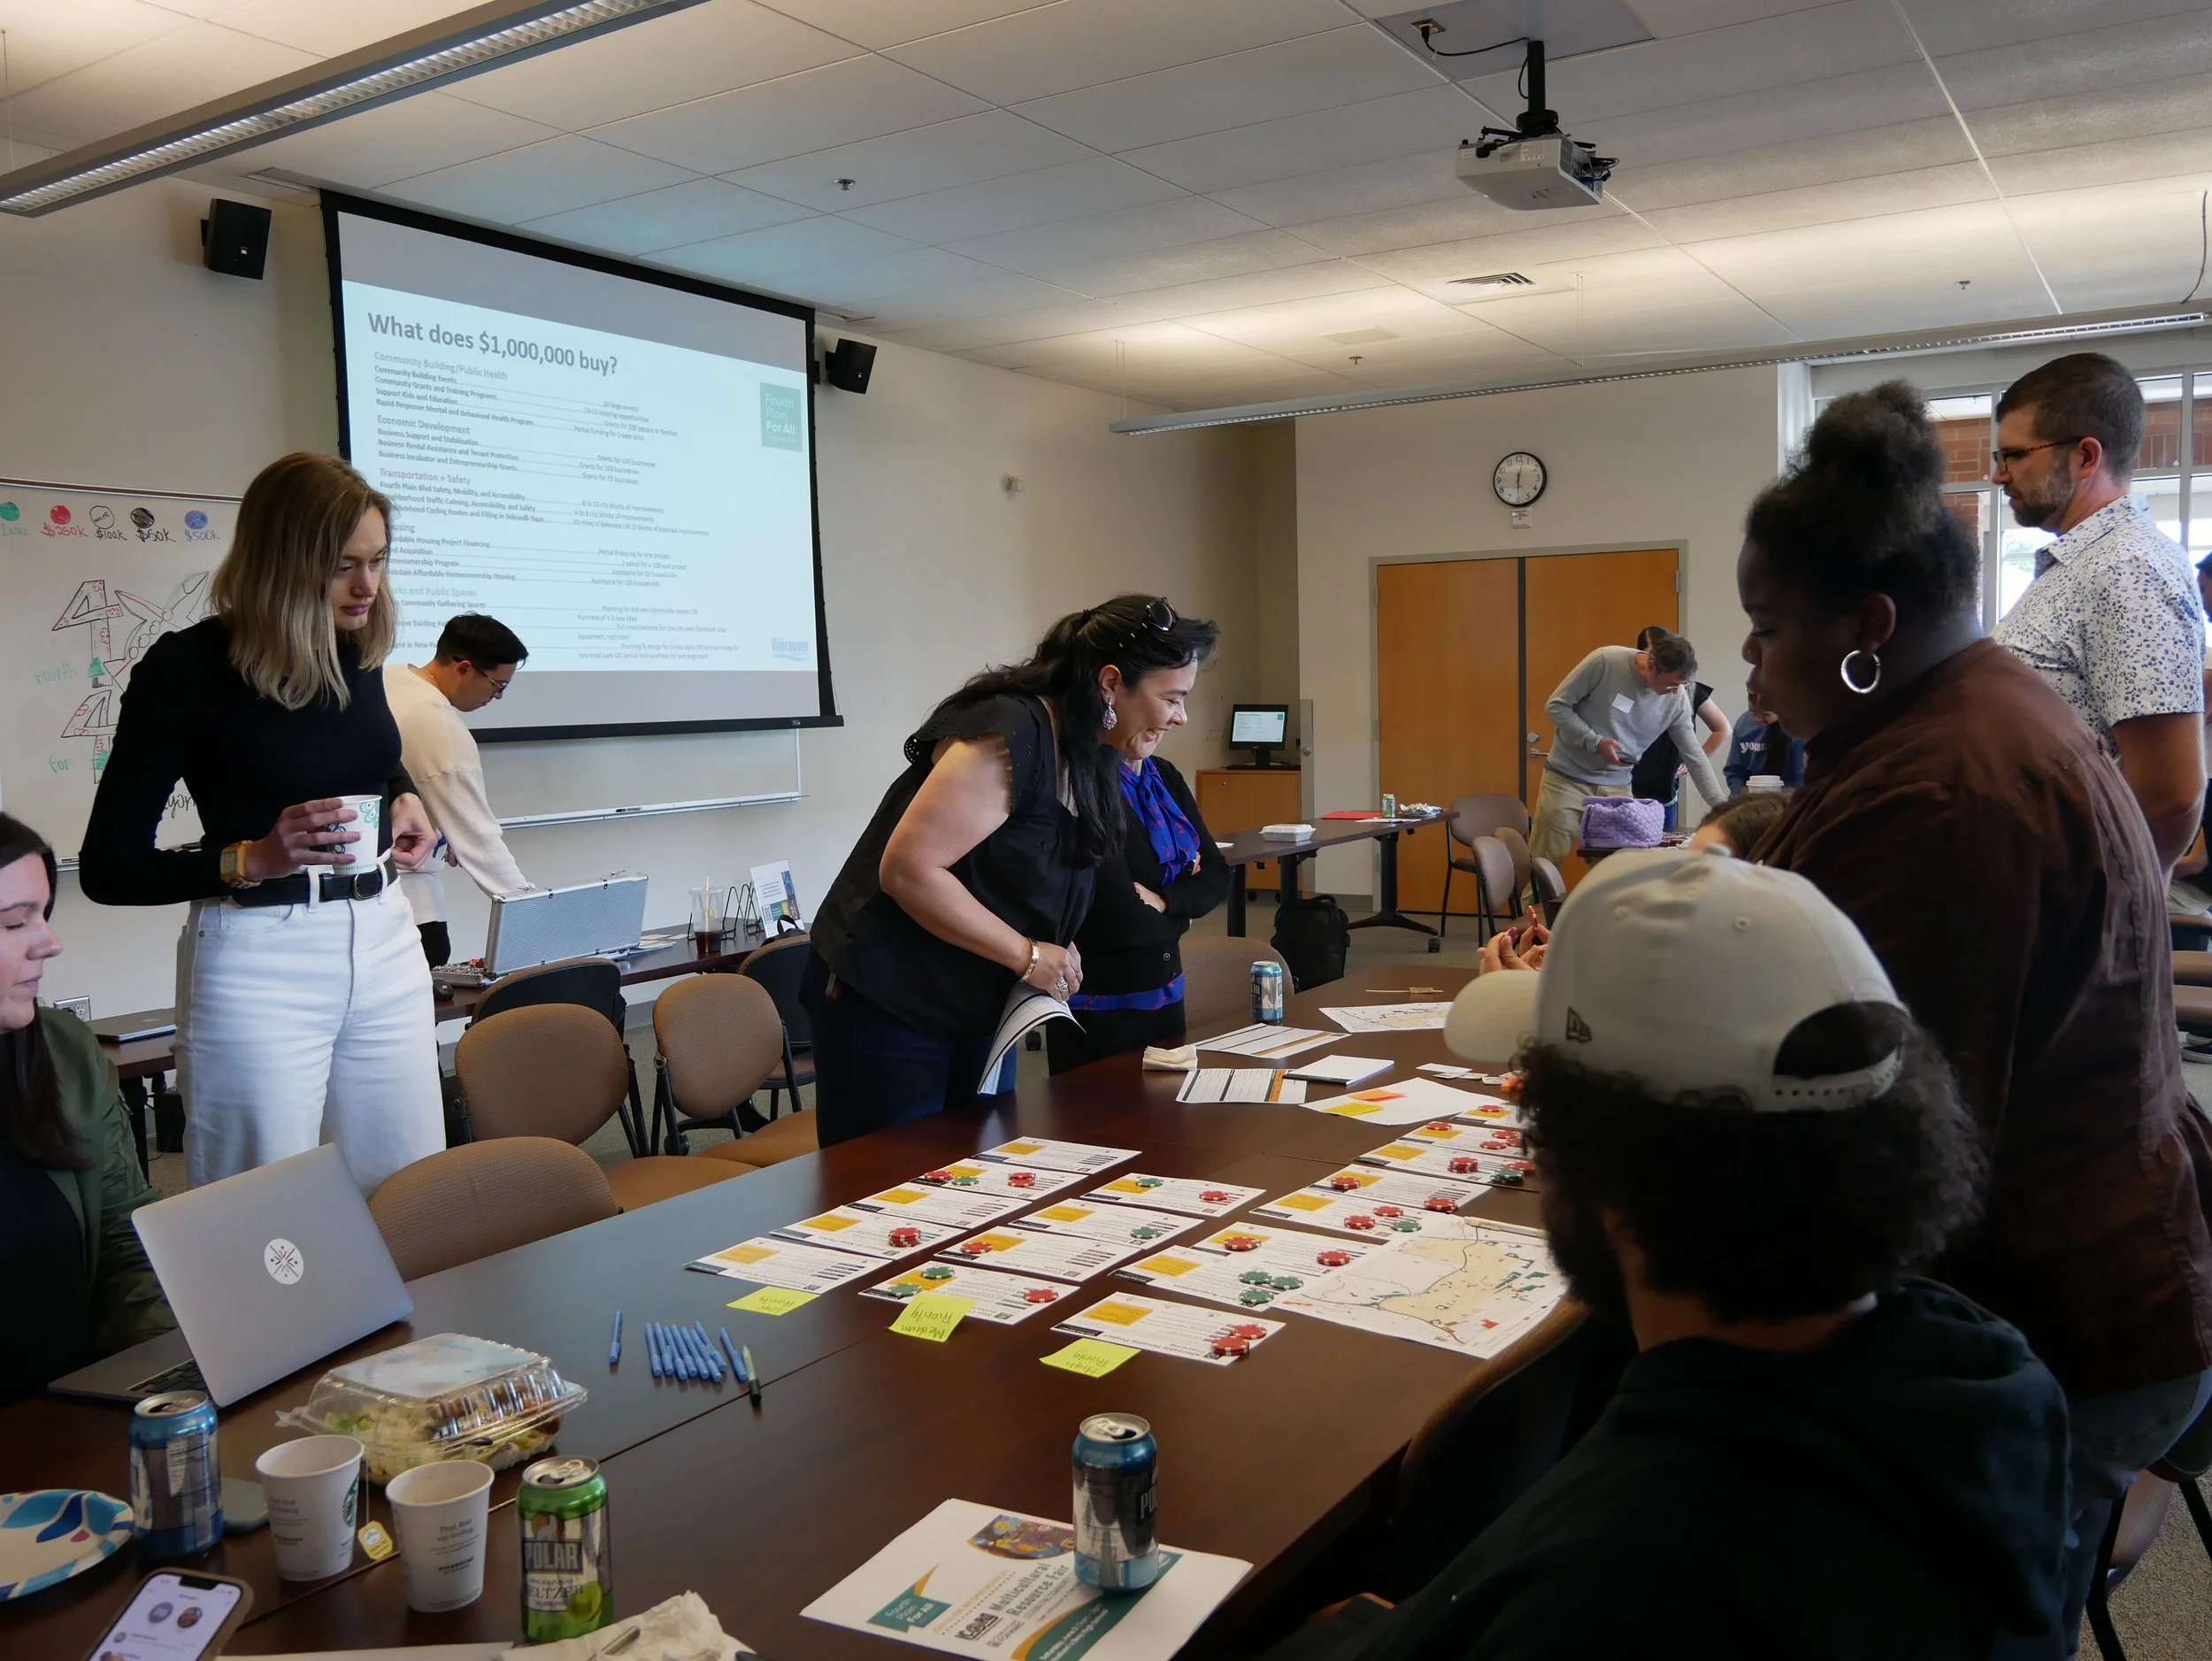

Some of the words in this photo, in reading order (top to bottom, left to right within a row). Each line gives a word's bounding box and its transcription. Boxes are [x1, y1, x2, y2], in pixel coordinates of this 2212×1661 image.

[369, 311, 423, 341] What
[429, 323, 473, 350] does
[479, 331, 575, 370] $1,000,000
[580, 350, 618, 379] buy?
[374, 350, 421, 368] Community
[424, 359, 481, 378] Building/Public
[484, 369, 508, 382] Health
[375, 365, 411, 377] Community
[412, 371, 436, 381] Building
[376, 376, 411, 388] Community
[413, 381, 432, 391] Grants
[447, 387, 469, 396] Training
[471, 391, 496, 401] Programs
[376, 388, 400, 397] Support
[430, 396, 458, 405] Education
[766, 393, 794, 409] Fourth
[377, 398, 394, 407] Rapid
[396, 401, 425, 411] Response
[426, 405, 447, 415] Mental
[461, 411, 490, 420] Behavioral
[511, 418, 534, 427] Program
[766, 406, 787, 420] Plain
[377, 415, 416, 428] Economic
[419, 420, 471, 435] Development
[767, 420, 781, 433] For
[783, 423, 795, 435] All
[378, 428, 404, 438] Business
[406, 432, 429, 441] Support
[444, 436, 479, 447] Stabilization
[378, 438, 404, 448] Business
[406, 442, 425, 450] Rental
[427, 444, 457, 454] Assistance
[471, 450, 489, 458] Tenant
[491, 452, 518, 462] Protection
[379, 450, 405, 459] Business
[407, 453, 434, 463] Incubator
[449, 458, 497, 470] Entrepreneurship
[499, 464, 518, 473] Grants
[380, 468, 438, 482] Transportation
[448, 475, 471, 486] Safety
[380, 481, 400, 490] Fourth
[492, 492, 525, 502] Accessibility
[446, 571, 492, 580] Homeownership
[426, 588, 449, 596] Public
[910, 1302, 954, 1324] Priority
[524, 1542, 579, 1570] POLAR
[988, 1561, 1051, 1611] Multicultural
[1005, 1580, 1054, 1617] Resource
[1050, 1563, 1071, 1582] Fair
[885, 1597, 912, 1618] Fourth
[906, 1609, 923, 1623] For
